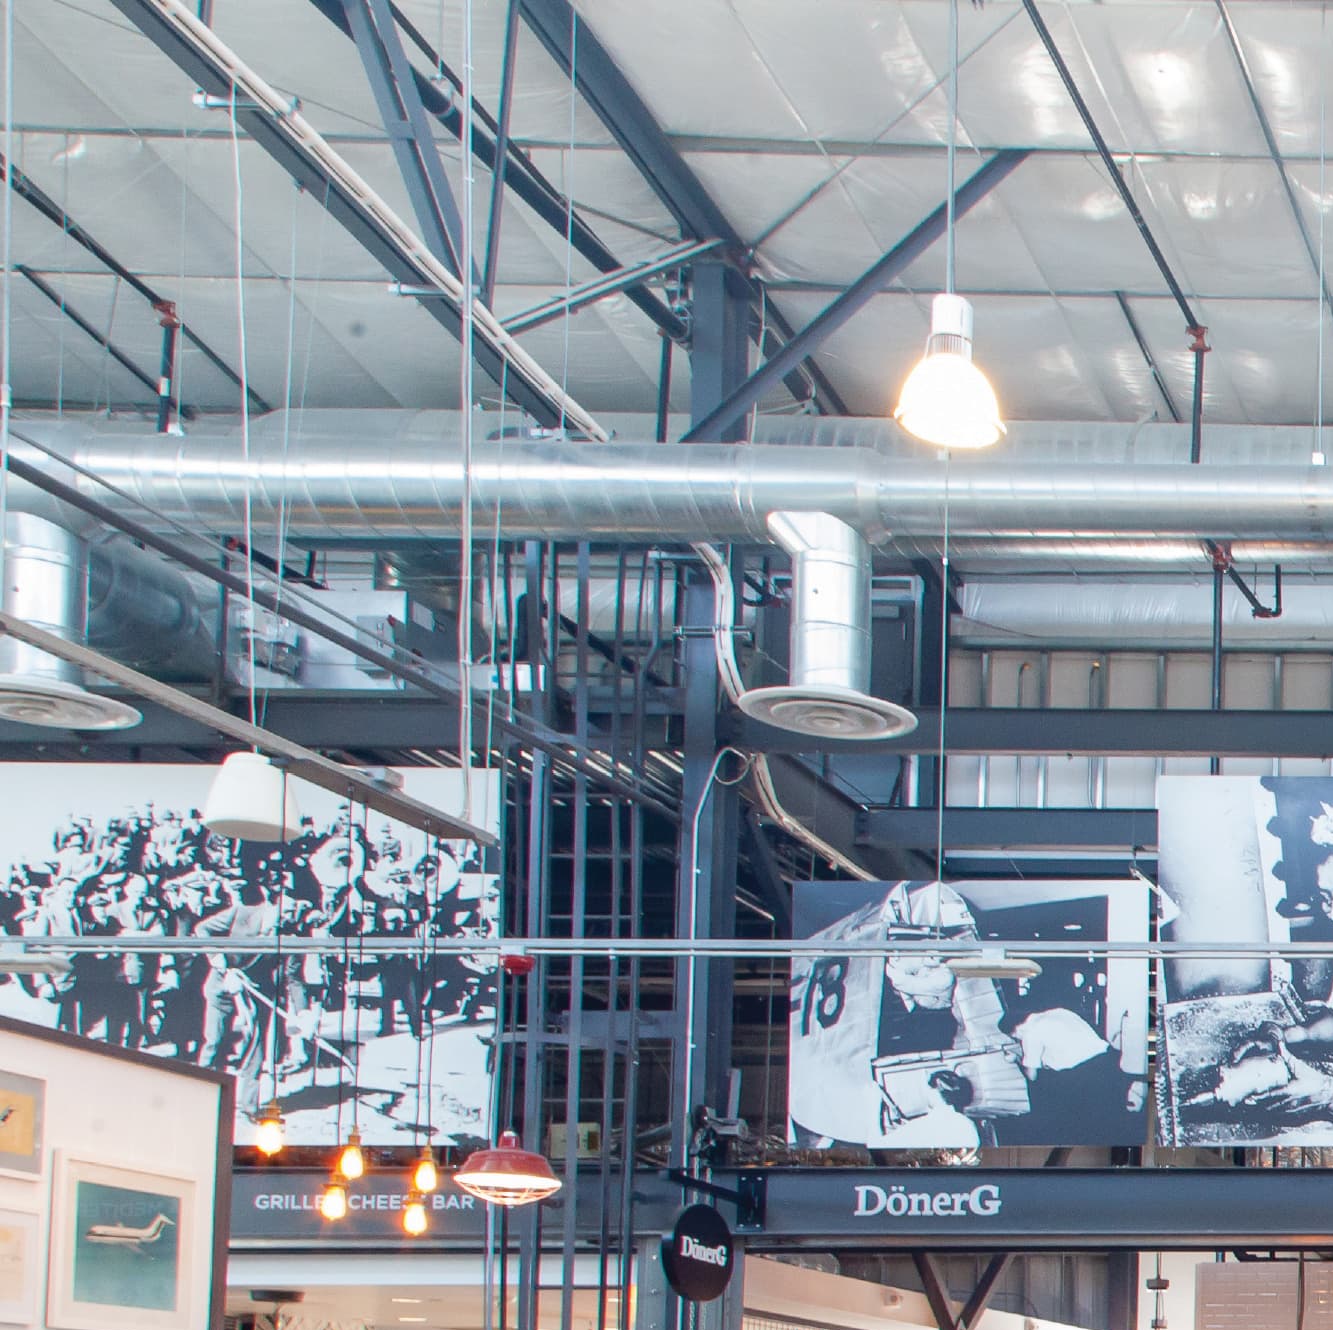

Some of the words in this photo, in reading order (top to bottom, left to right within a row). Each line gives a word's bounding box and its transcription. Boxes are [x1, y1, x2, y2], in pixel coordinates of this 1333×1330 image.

[254, 1194, 327, 1210] GRILLE
[432, 1194, 475, 1210] BAR
[853, 1184, 1001, 1217] DönerG
[680, 1235, 727, 1267] DönerG
